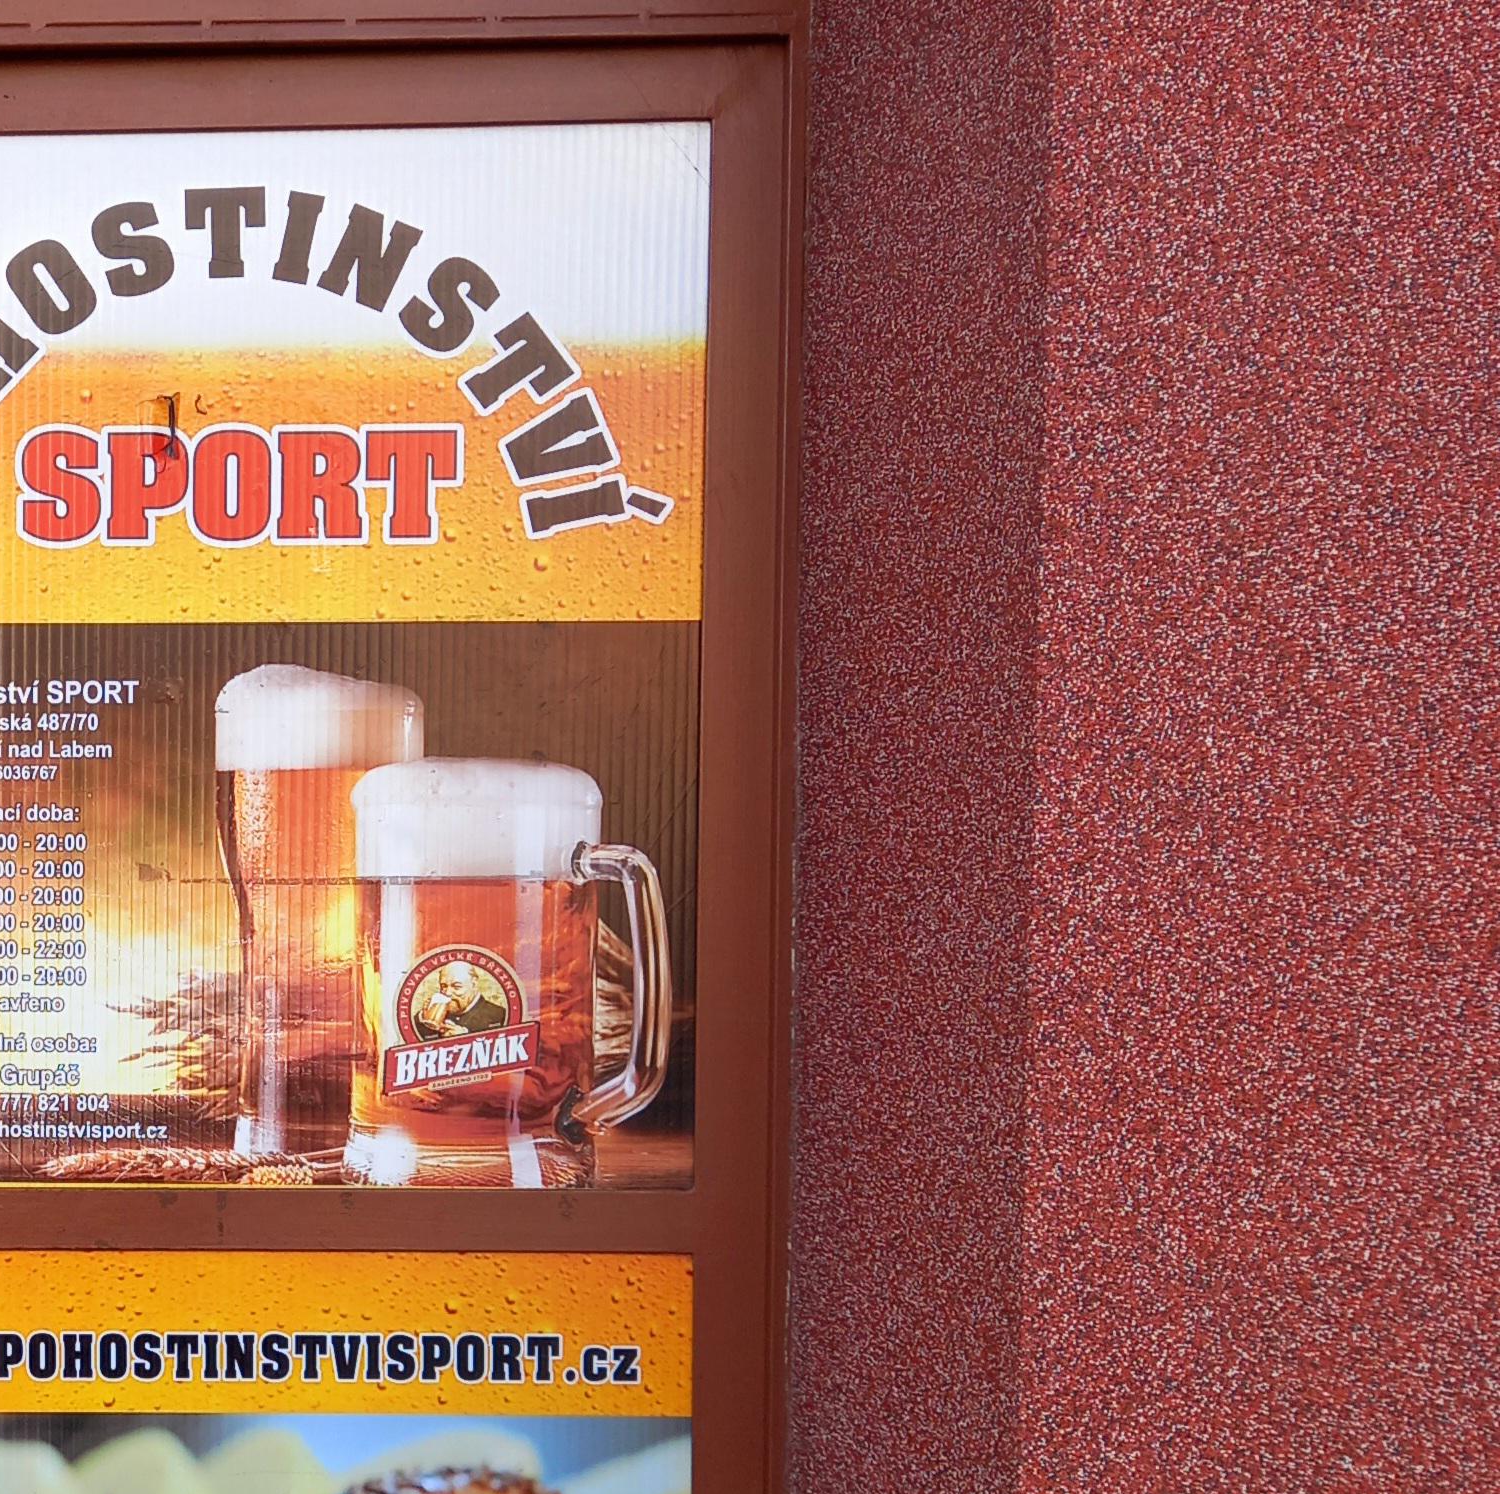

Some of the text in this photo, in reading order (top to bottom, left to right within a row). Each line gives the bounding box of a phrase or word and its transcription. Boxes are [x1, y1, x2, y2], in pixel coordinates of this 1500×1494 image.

[20, 428, 462, 544] SPORT
[46, 680, 140, 704] SPORT
[37, 714, 99, 731] 487/70
[8, 740, 43, 758] nad
[49, 740, 113, 758] Labem
[26, 803, 80, 822] doba:
[35, 833, 87, 851] 20:00
[33, 861, 84, 878] 20:00
[33, 887, 84, 905] 20:00
[33, 914, 84, 931] 20:00
[35, 940, 86, 958] 22:00
[34, 967, 87, 985] 20:00
[401, 966, 427, 1018] PIVOVAR
[432, 953, 473, 966] VELKÉ
[31, 1035, 97, 1052] osoba:
[393, 1033, 530, 1087] BŘEZŇÁK
[0, 1064, 80, 1089] Grupáč
[1, 1094, 33, 1111] 777
[38, 1094, 69, 1111] 821
[77, 1094, 109, 1111] 804
